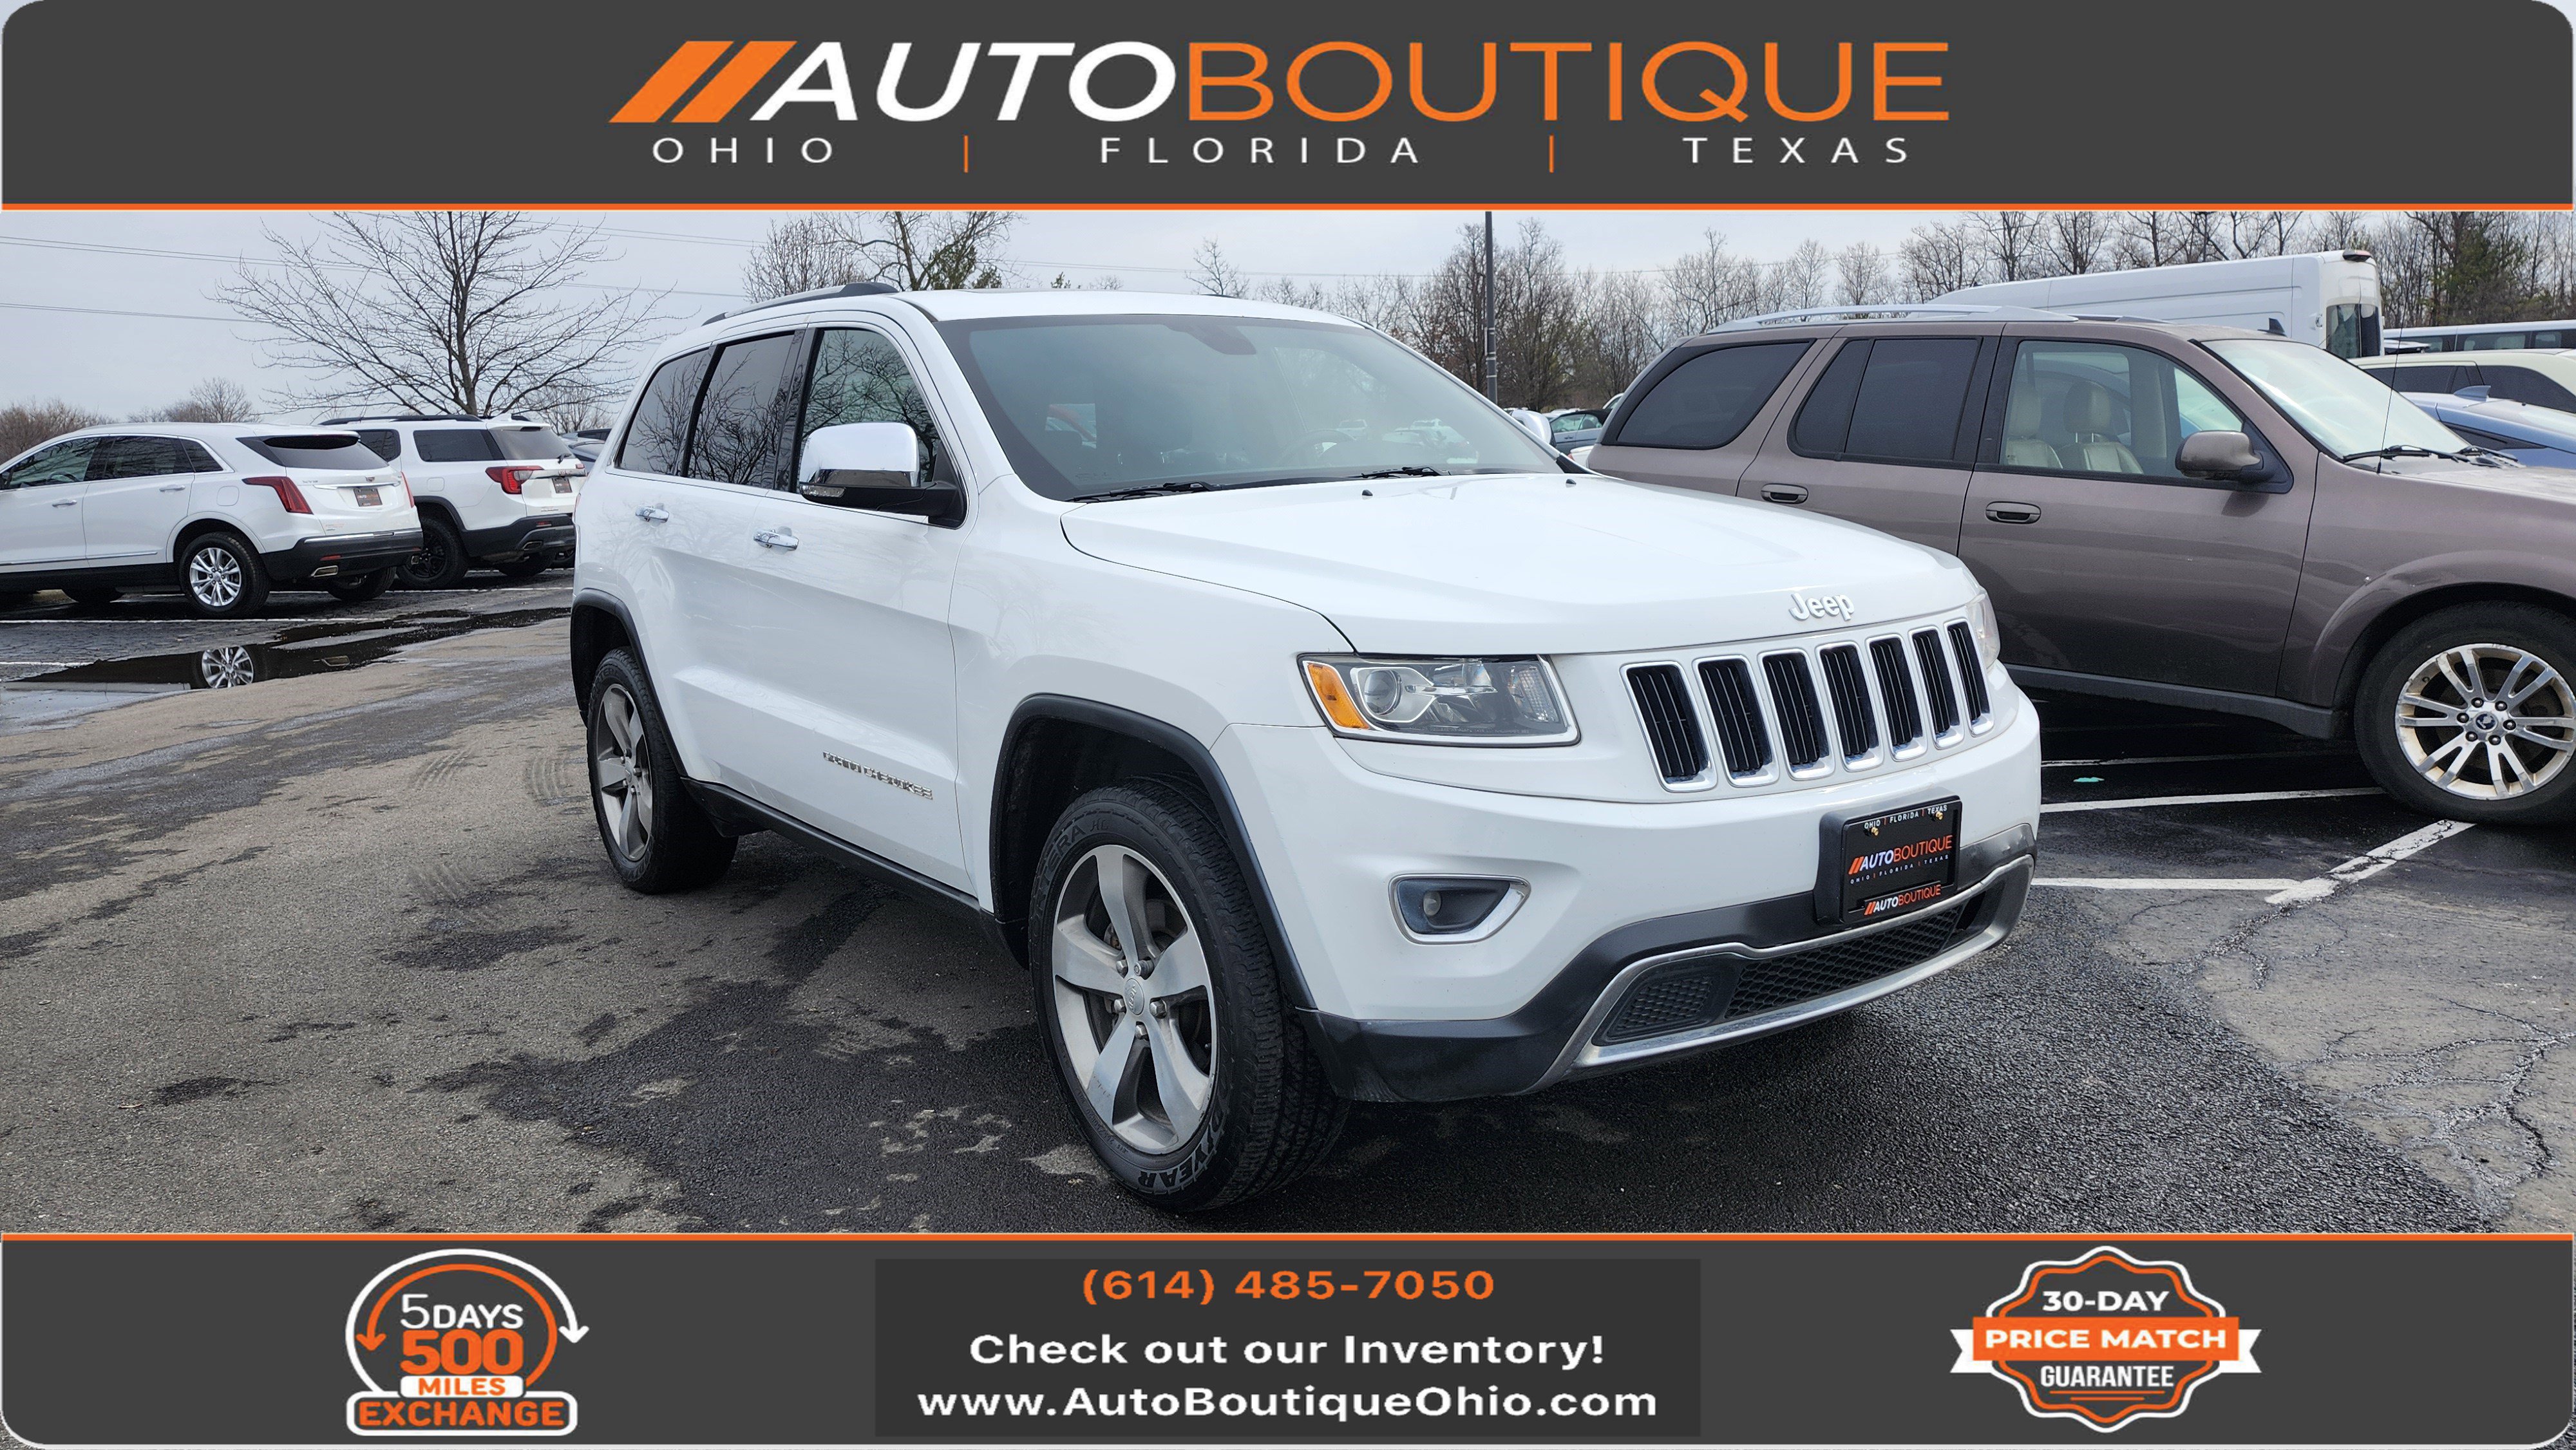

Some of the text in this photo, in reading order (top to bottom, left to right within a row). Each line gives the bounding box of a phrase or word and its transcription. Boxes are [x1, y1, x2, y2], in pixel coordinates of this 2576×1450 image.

[1788, 592, 1855, 621] Jeep
[1864, 805, 1948, 829] OHIO FLORIDA TEXAS
[1859, 834, 1953, 872] AUTOBOUTIQUE
[1850, 854, 1949, 884] OHIO FLORIDA TEXAS
[1873, 884, 1942, 913] AUTOBOUTIQUE
